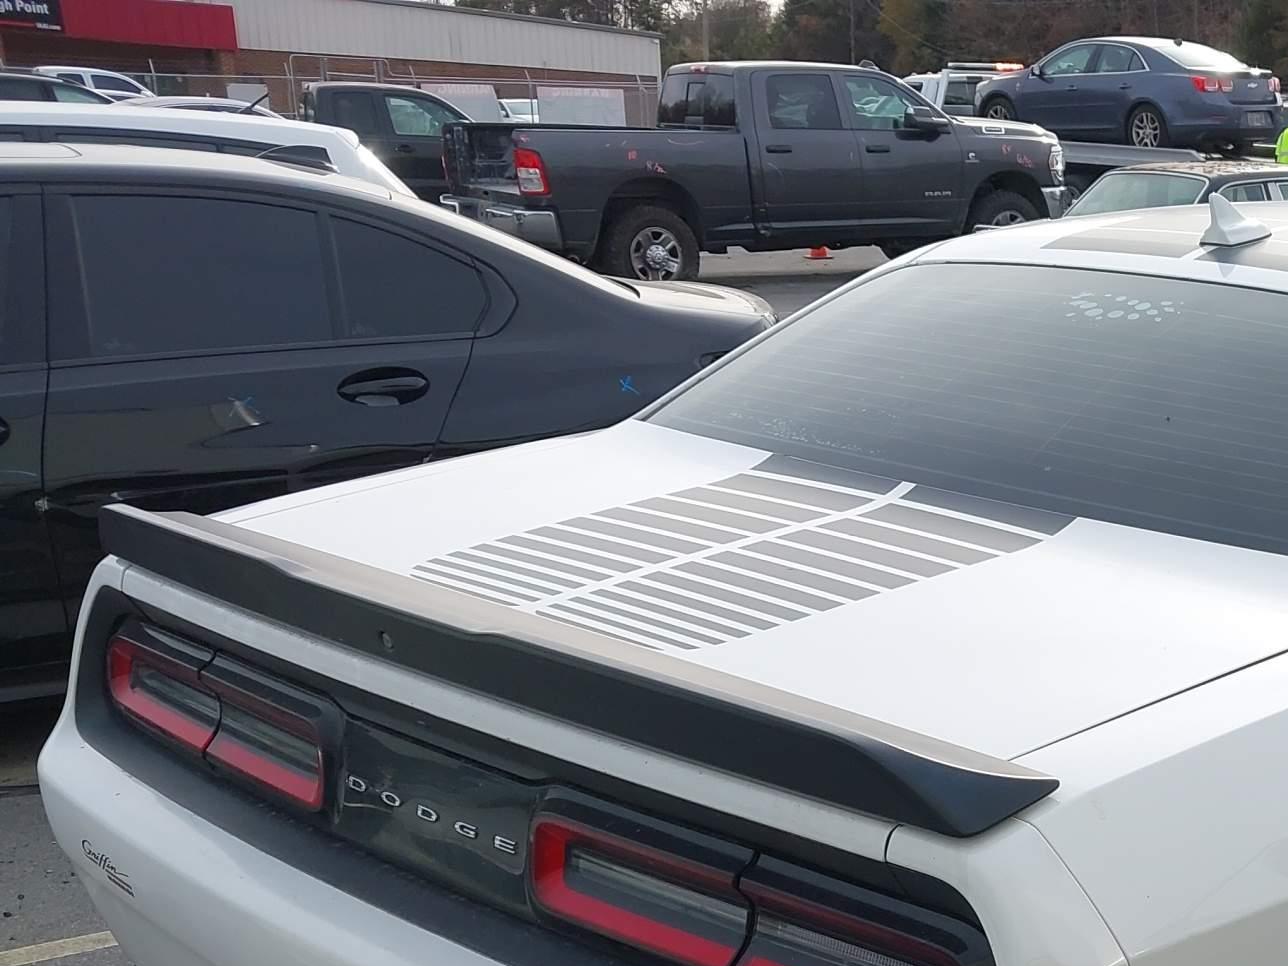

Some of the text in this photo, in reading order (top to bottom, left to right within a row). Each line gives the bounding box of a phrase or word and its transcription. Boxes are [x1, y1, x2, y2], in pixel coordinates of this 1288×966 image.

[15, 0, 49, 15] Point
[348, 775, 517, 855] DODGE
[81, 839, 129, 877] Griffin
